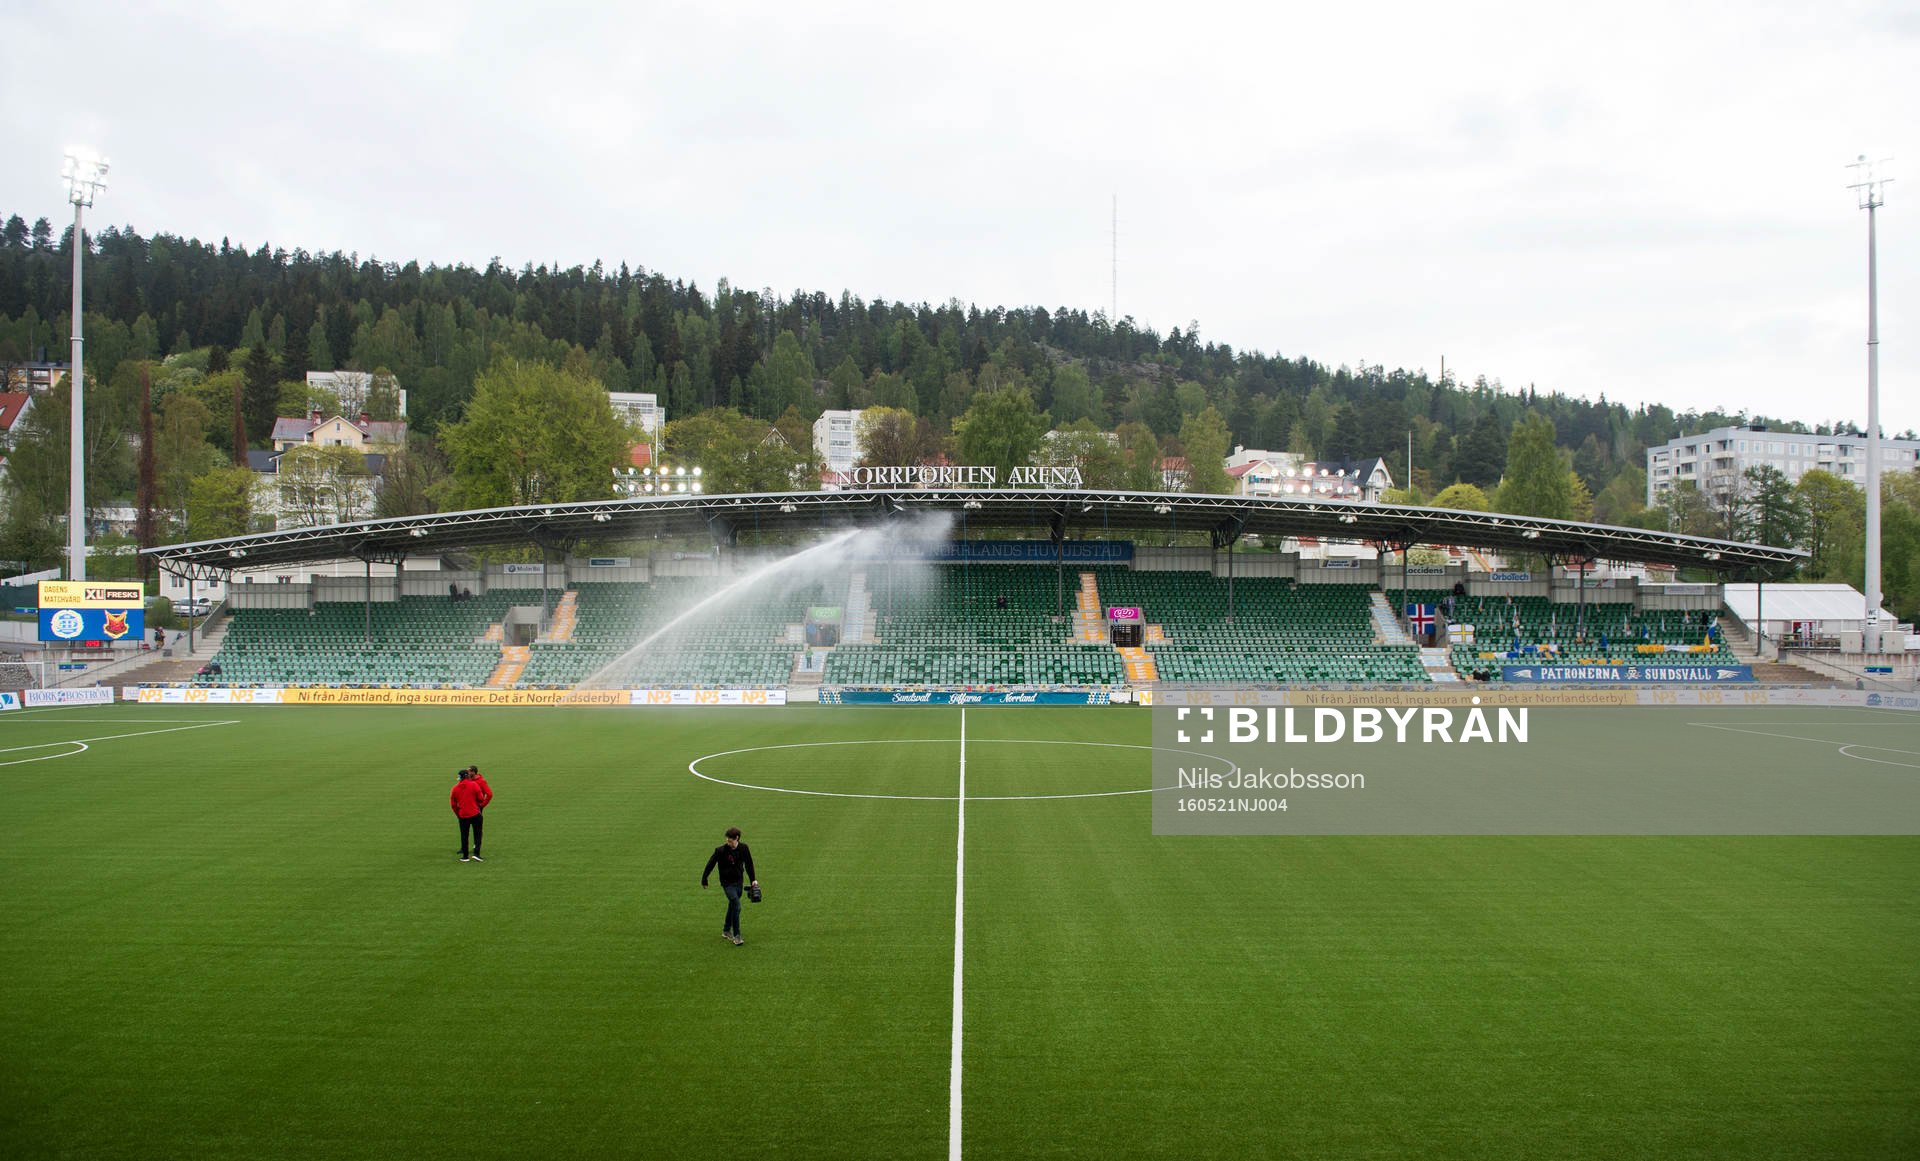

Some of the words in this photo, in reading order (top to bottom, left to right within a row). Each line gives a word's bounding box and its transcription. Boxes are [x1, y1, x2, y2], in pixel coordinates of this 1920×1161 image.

[836, 466, 996, 485] NORRPORTEN
[1008, 466, 1084, 485] ARENA
[1026, 544, 1122, 557] HUVUDSTAD
[1408, 566, 1444, 574] occidens
[1491, 573, 1529, 581] OrboTech
[107, 591, 138, 599] FRESKS
[1540, 667, 1620, 680] PATRONERNA
[1645, 667, 1712, 680] SUNDSVALL
[298, 691, 310, 702] Ni
[313, 691, 335, 702] från
[395, 692, 421, 705] inga
[423, 694, 448, 703] sura
[450, 694, 486, 704] miner.
[489, 693, 509, 703] Det
[511, 693, 524, 703] är
[647, 690, 671, 704] NP3
[695, 690, 719, 704] NP3
[742, 690, 767, 704] NP3
[892, 692, 931, 703] Sundsvall
[1000, 692, 1037, 703] Norrland
[1305, 694, 1318, 704] Ni
[1321, 693, 1344, 704] från
[1406, 695, 1431, 707] inga
[1434, 696, 1458, 705] sura
[1499, 694, 1519, 704] Det
[1521, 694, 1533, 704] är
[1536, 693, 1628, 706] Norrlandsderby!
